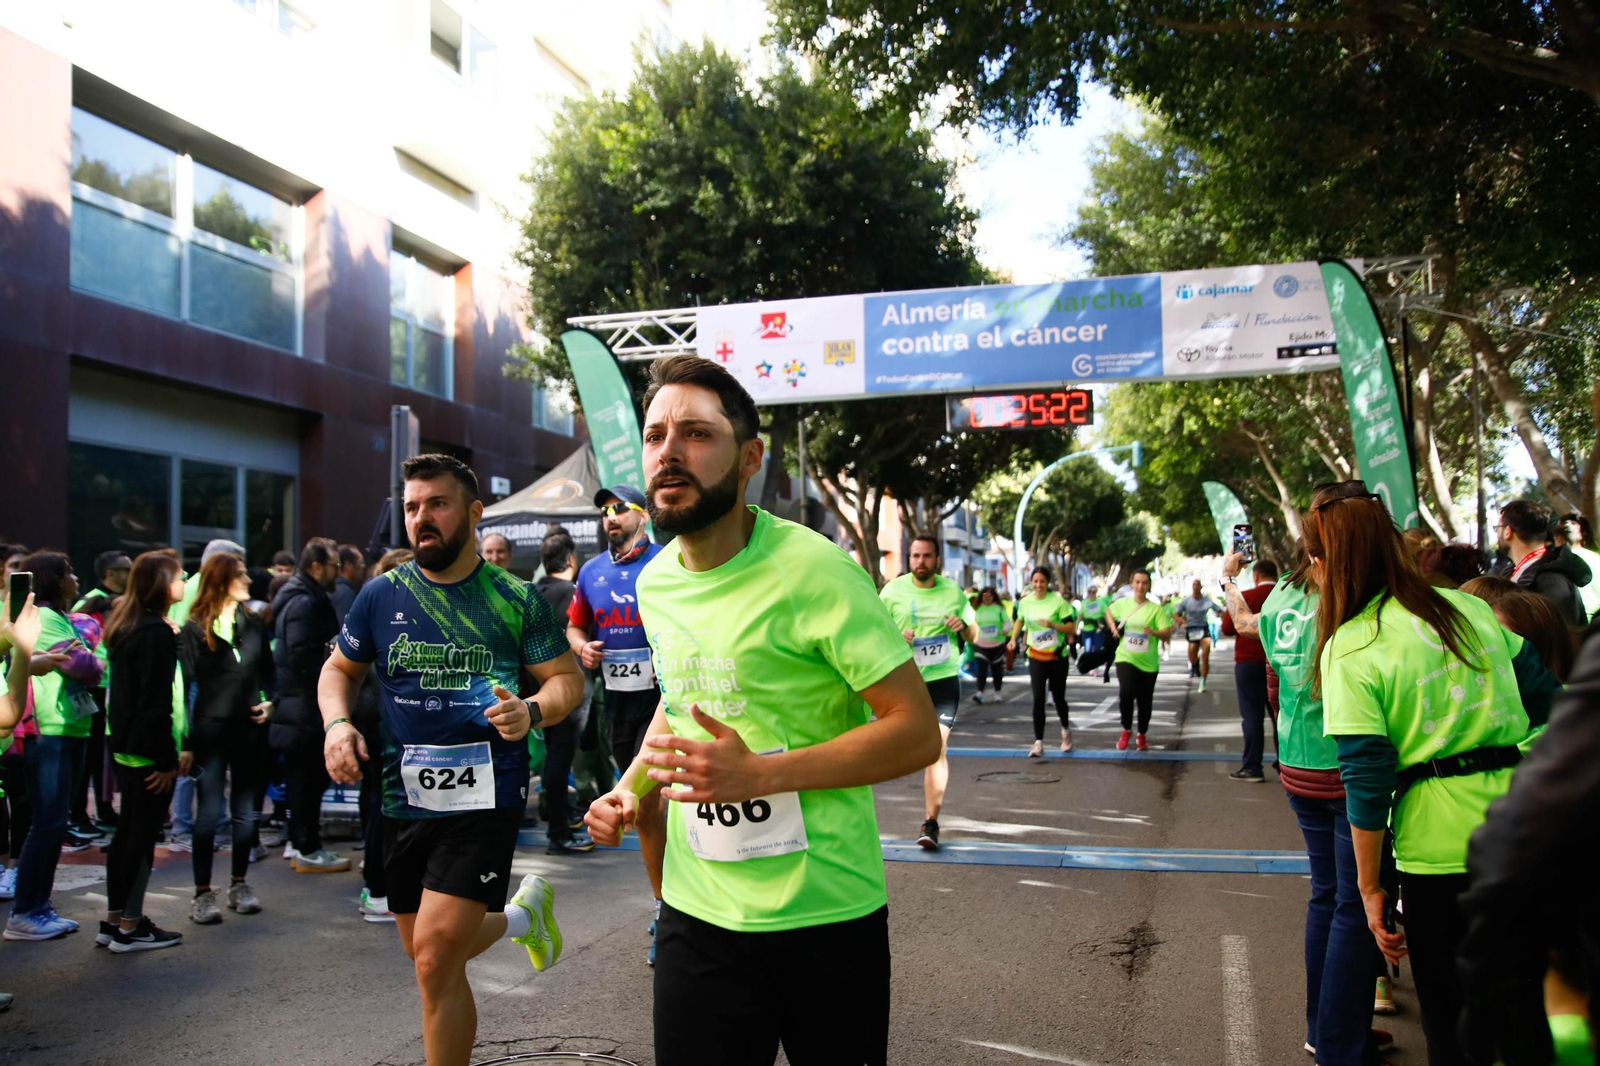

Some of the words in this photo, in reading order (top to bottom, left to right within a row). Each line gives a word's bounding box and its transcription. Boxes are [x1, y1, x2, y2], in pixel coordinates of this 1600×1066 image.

[1198, 283, 1255, 298] cajamar
[882, 298, 986, 326] Almería
[995, 299, 1027, 317] en
[1037, 289, 1142, 313] marcha
[1254, 311, 1321, 327] Fundación
[882, 330, 969, 356] contra
[977, 325, 1003, 349] el
[1010, 322, 1107, 347] cáncer
[409, 643, 419, 654] X
[419, 642, 445, 655] Carrera
[921, 643, 943, 656] 127
[444, 643, 493, 673] Cortijo
[609, 663, 641, 678] 224
[421, 671, 438, 689] del
[720, 673, 742, 693] el
[418, 767, 477, 790] 624
[696, 799, 771, 828] 466
[750, 843, 773, 852] febrero
[783, 838, 798, 846] 2025
